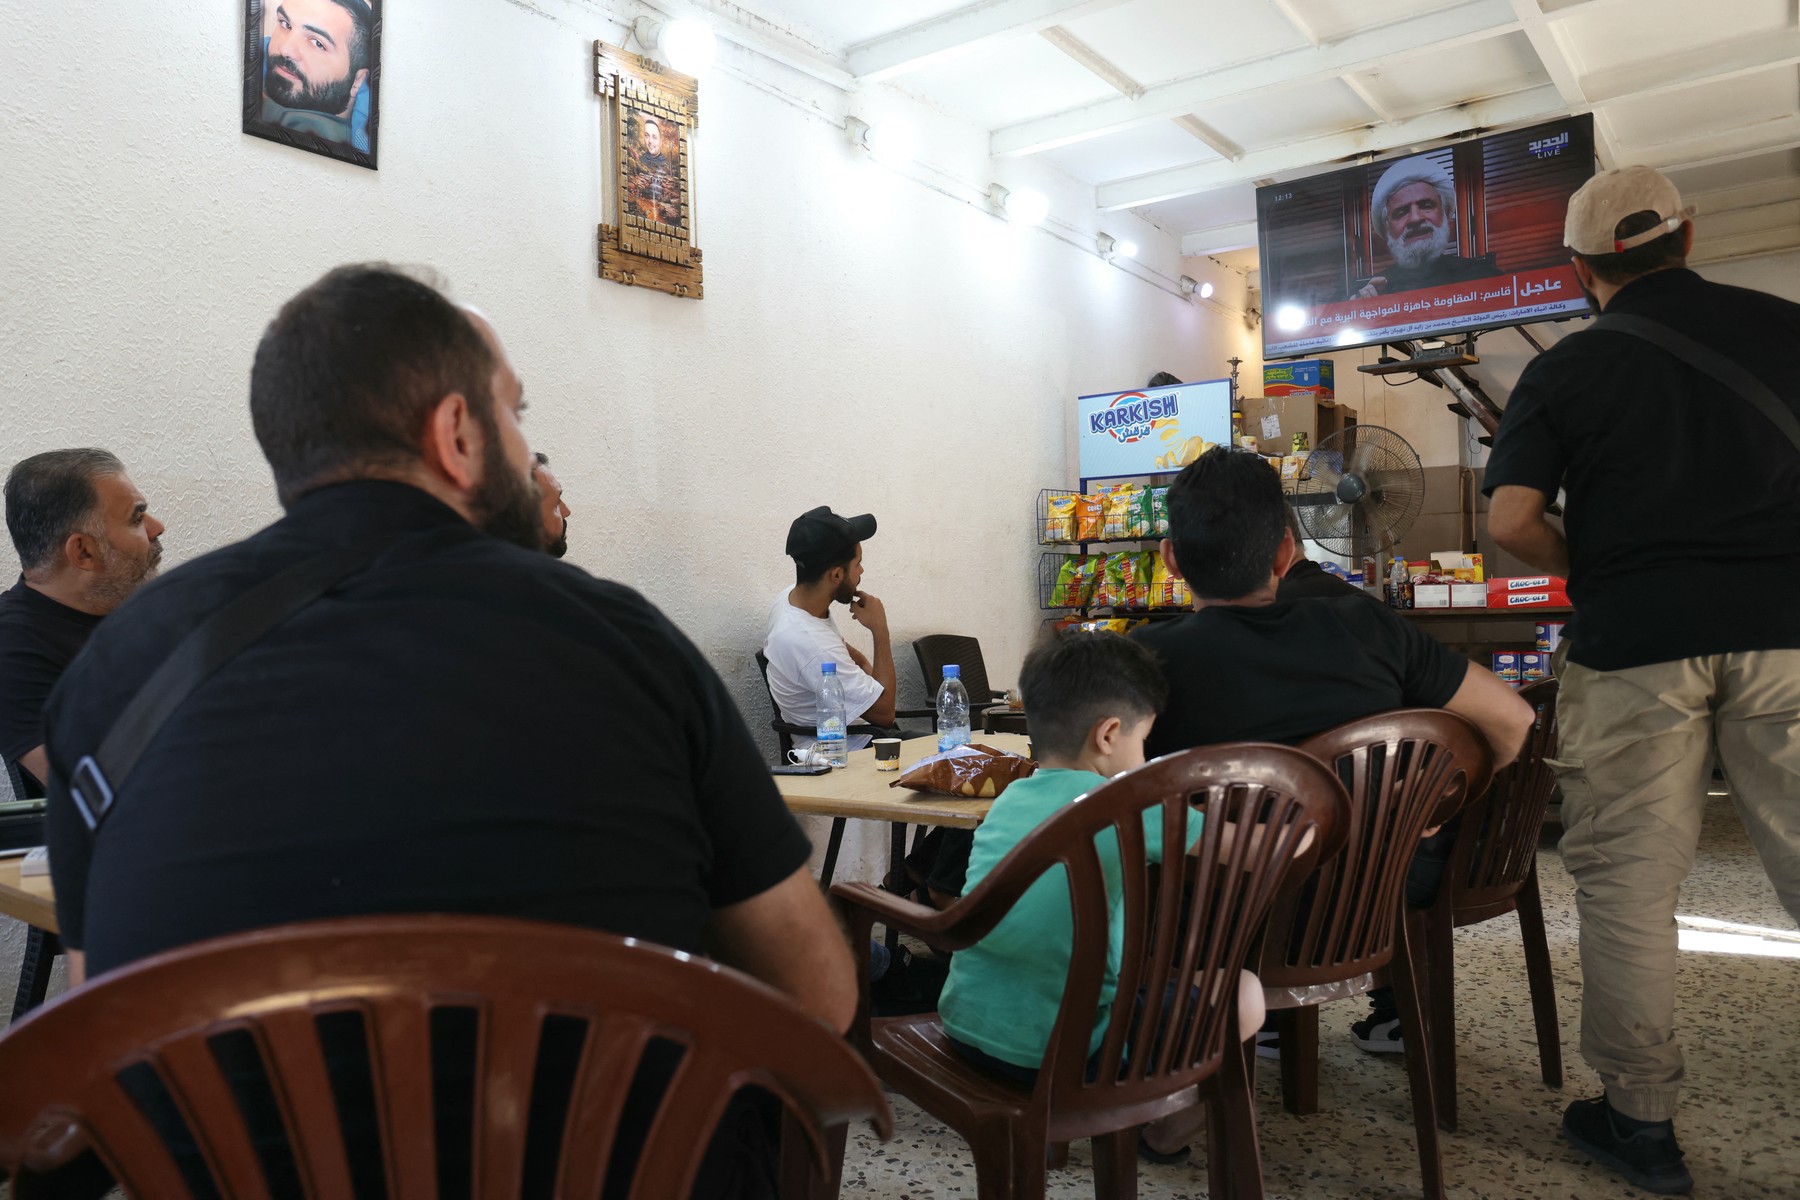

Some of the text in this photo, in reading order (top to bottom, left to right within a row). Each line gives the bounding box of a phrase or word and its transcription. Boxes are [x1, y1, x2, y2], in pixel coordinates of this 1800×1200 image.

[1529, 132, 1569, 153] الجديد
[1537, 148, 1561, 159] LIVE
[1274, 192, 1293, 202] 12:13
[1479, 286, 1511, 302] قاسم:
[1520, 279, 1562, 297] عاجل
[1403, 298, 1432, 314] جاهزة
[1433, 291, 1477, 307] المقاومة
[1334, 310, 1357, 323] البرية
[1359, 303, 1401, 319] للمواجهة
[1319, 316, 1333, 327] مع
[1090, 394, 1178, 433] KARKISH
[1117, 425, 1152, 443] قرقش
